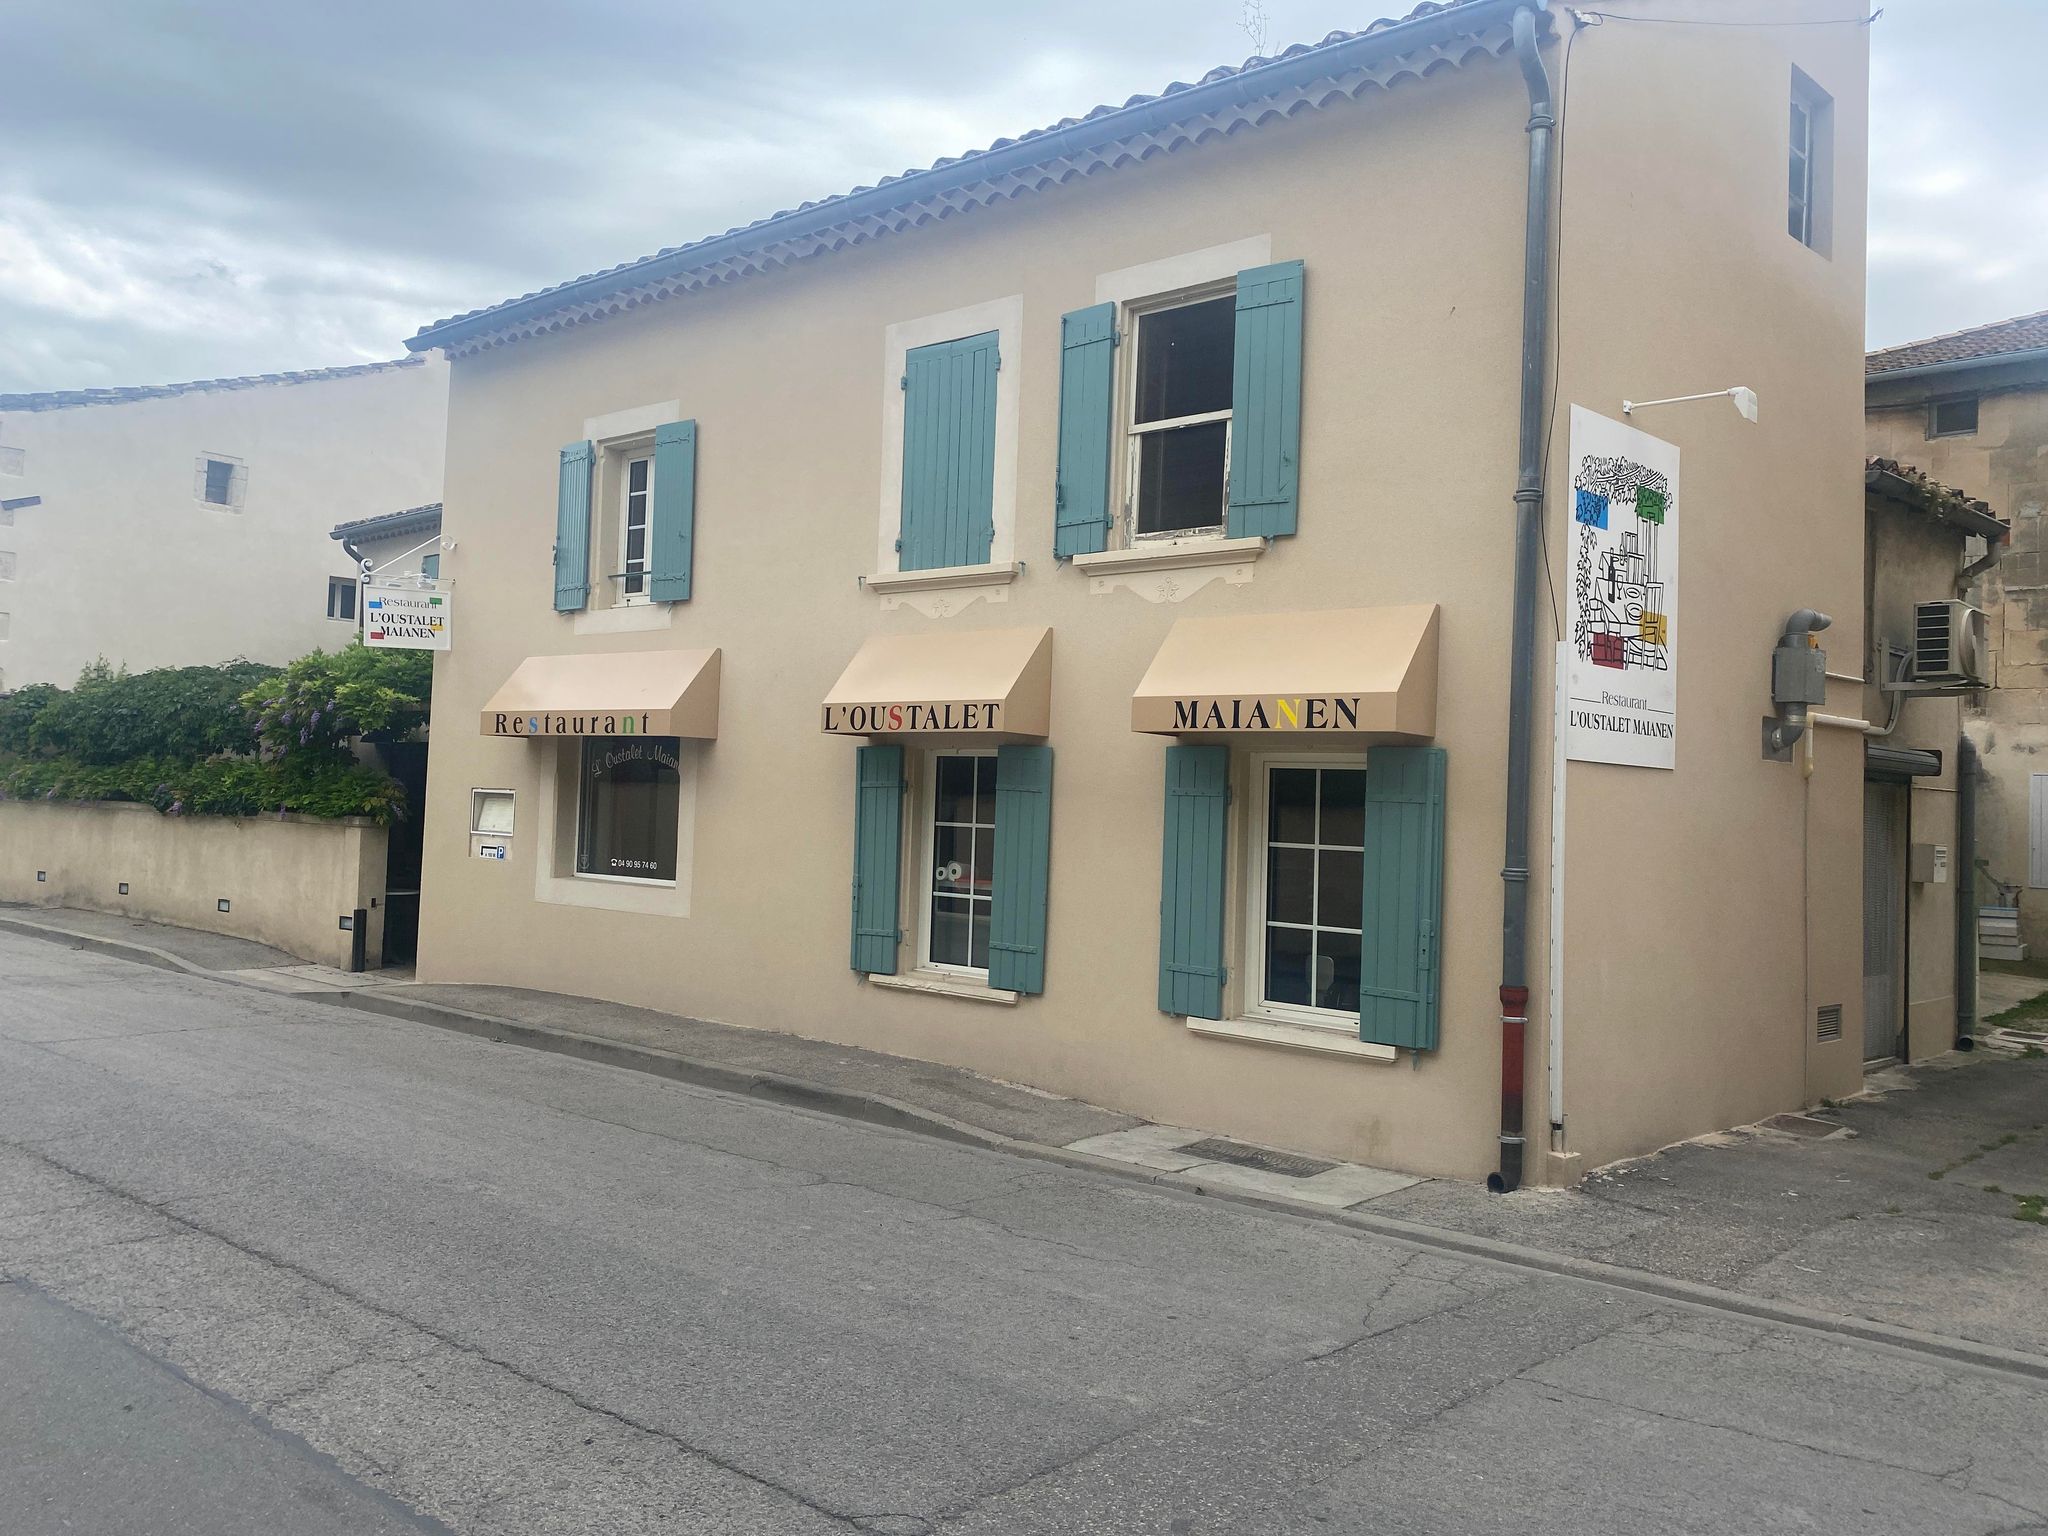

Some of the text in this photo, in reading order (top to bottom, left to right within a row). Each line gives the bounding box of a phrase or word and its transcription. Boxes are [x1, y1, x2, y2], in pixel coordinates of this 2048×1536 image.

[370, 612, 445, 627] L'OUSTALET
[380, 625, 436, 639] MAIANEN
[1601, 690, 1647, 711] Restaurant
[494, 712, 650, 735] Restaurant
[824, 703, 1001, 731] L'OUSTALET
[1172, 697, 1361, 730] MAIANEN
[1570, 710, 1674, 739] L'OUSTALET MAIANEN
[617, 859, 625, 868] 04
[625, 859, 633, 868] 90
[633, 860, 641, 869] 95
[641, 860, 649, 869] 74
